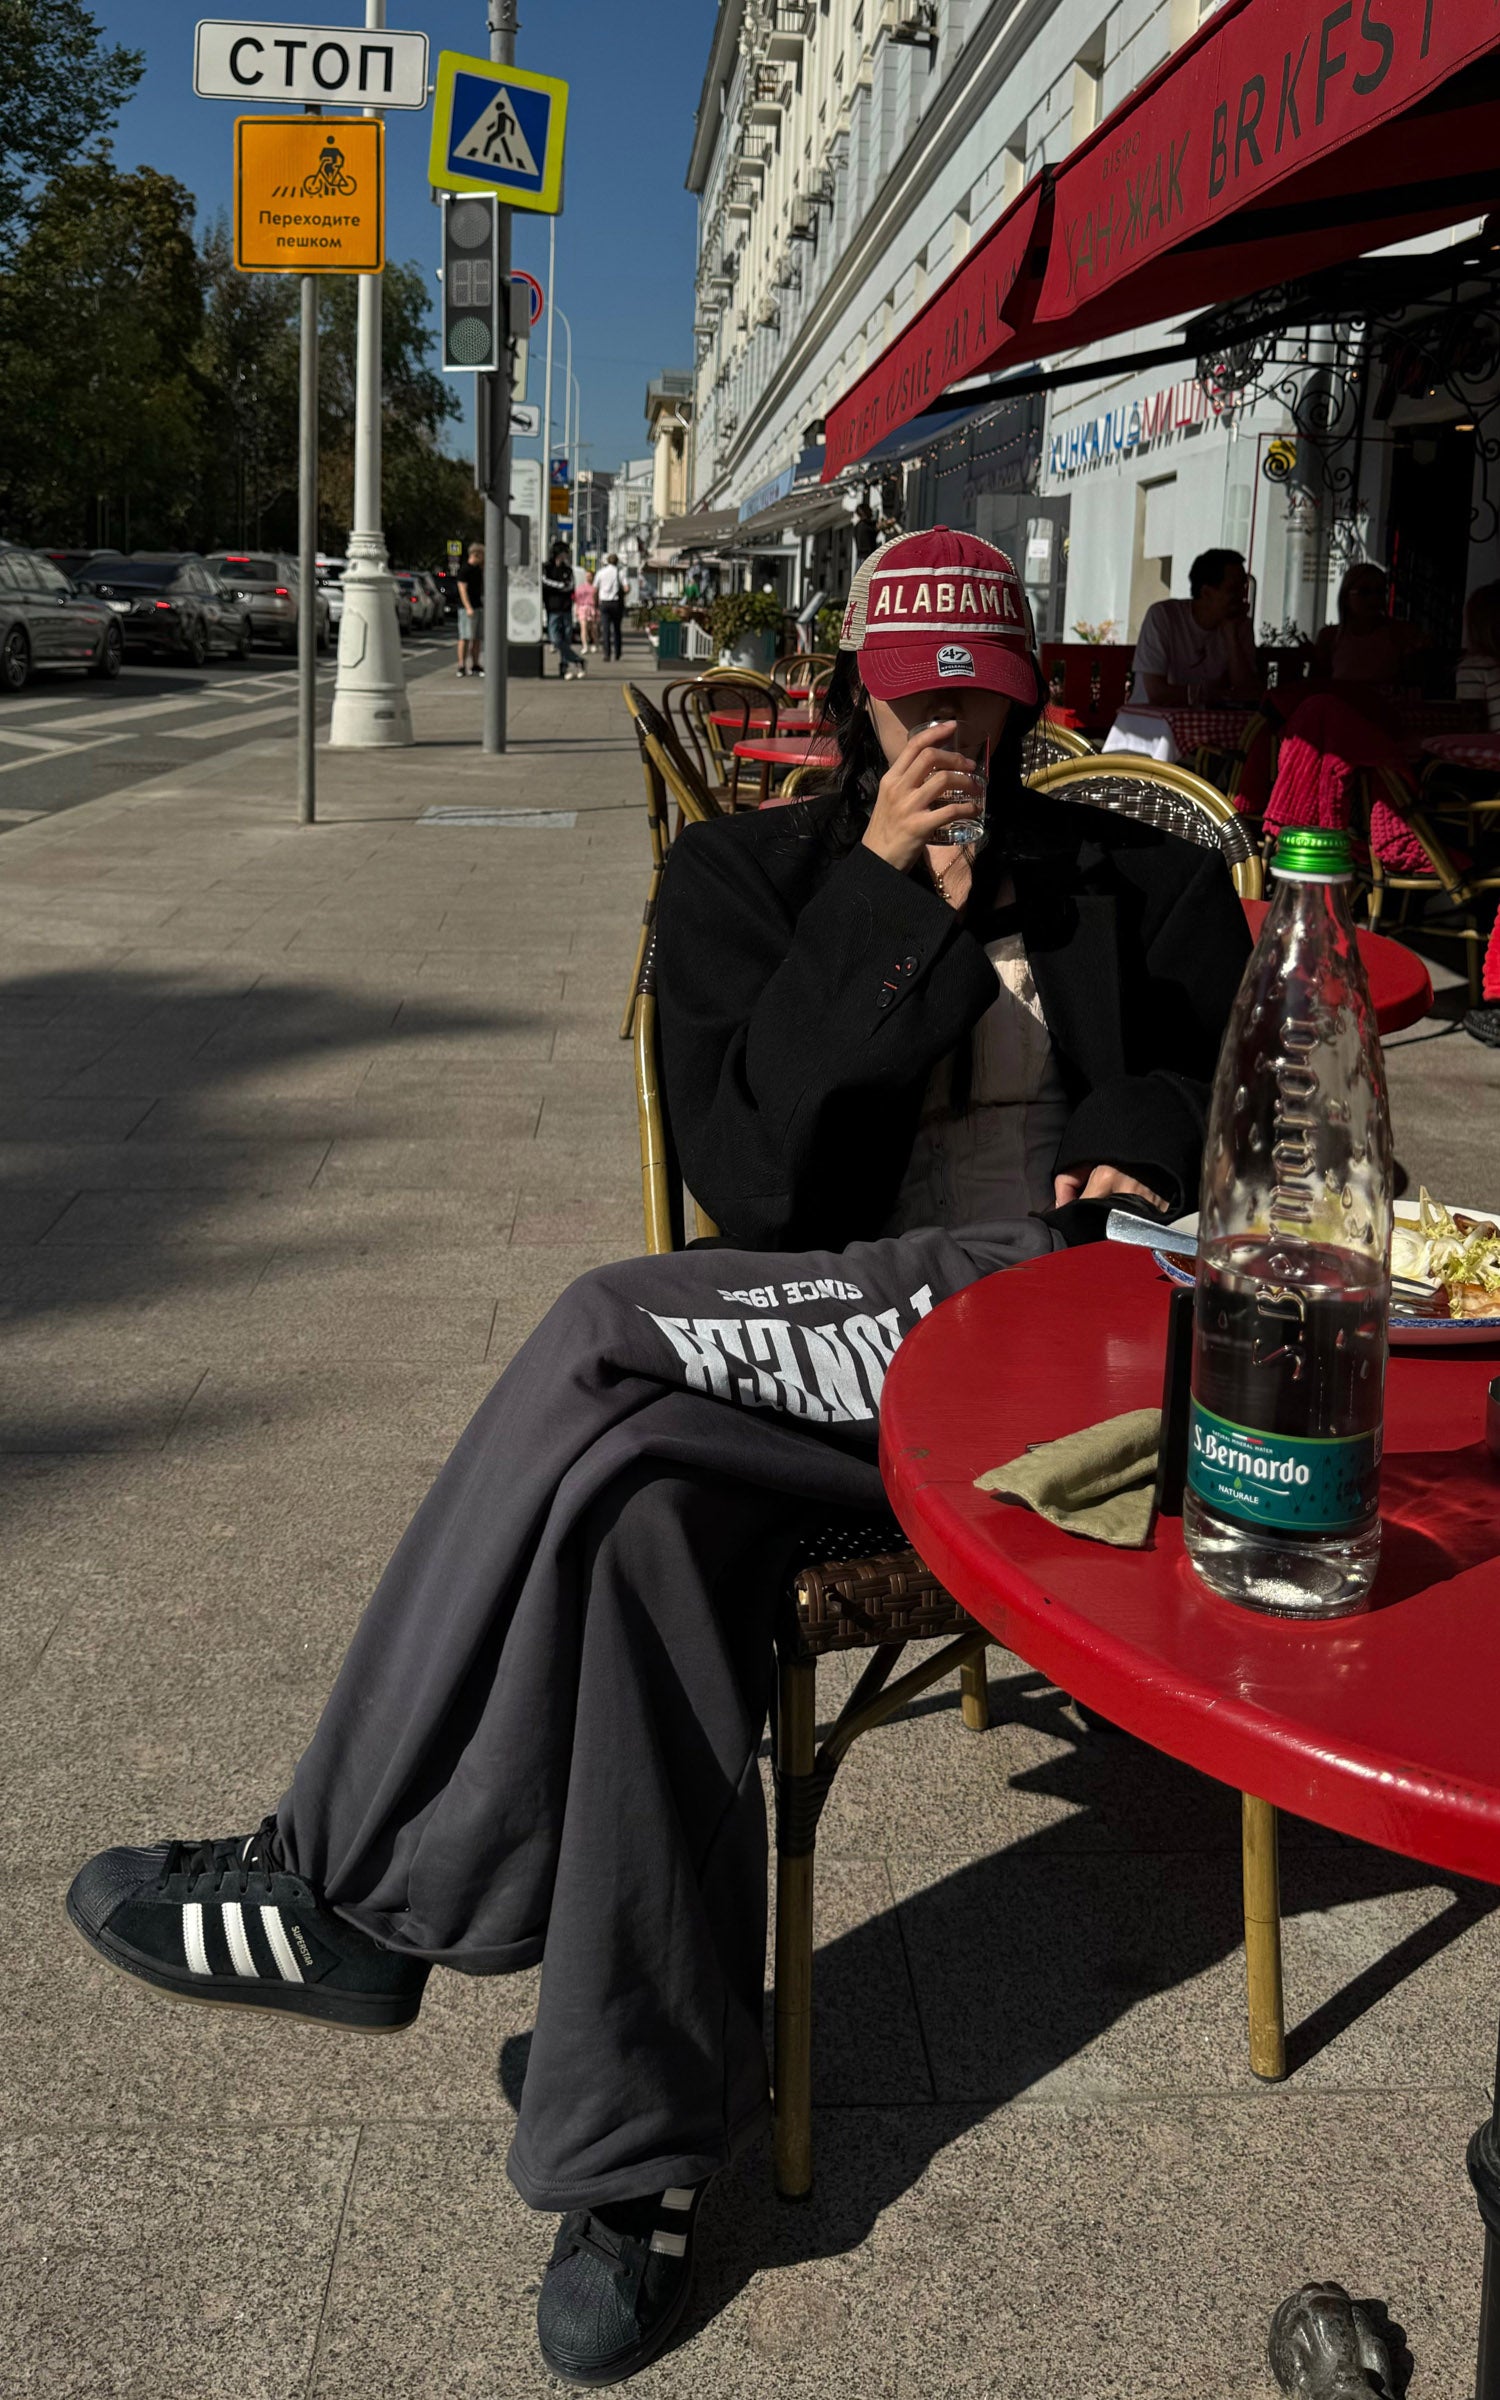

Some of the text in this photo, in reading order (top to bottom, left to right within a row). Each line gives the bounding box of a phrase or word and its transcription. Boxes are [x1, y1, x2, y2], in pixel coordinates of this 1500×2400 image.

[229, 36, 394, 92] СТОП
[1102, 130, 1141, 181] BISTRO
[258, 210, 361, 227] Переходите
[275, 236, 342, 248] пешком
[874, 582, 1019, 619] ALABAMA
[782, 1278, 864, 1305] SINCE
[1193, 1424, 1310, 1485] S.Bernardo
[1231, 1438, 1253, 1450] MINERAL
[1254, 1445, 1273, 1454] WATER
[1218, 1483, 1260, 1505] NATURALE
[291, 1925, 314, 1966] SUPERSTAR
